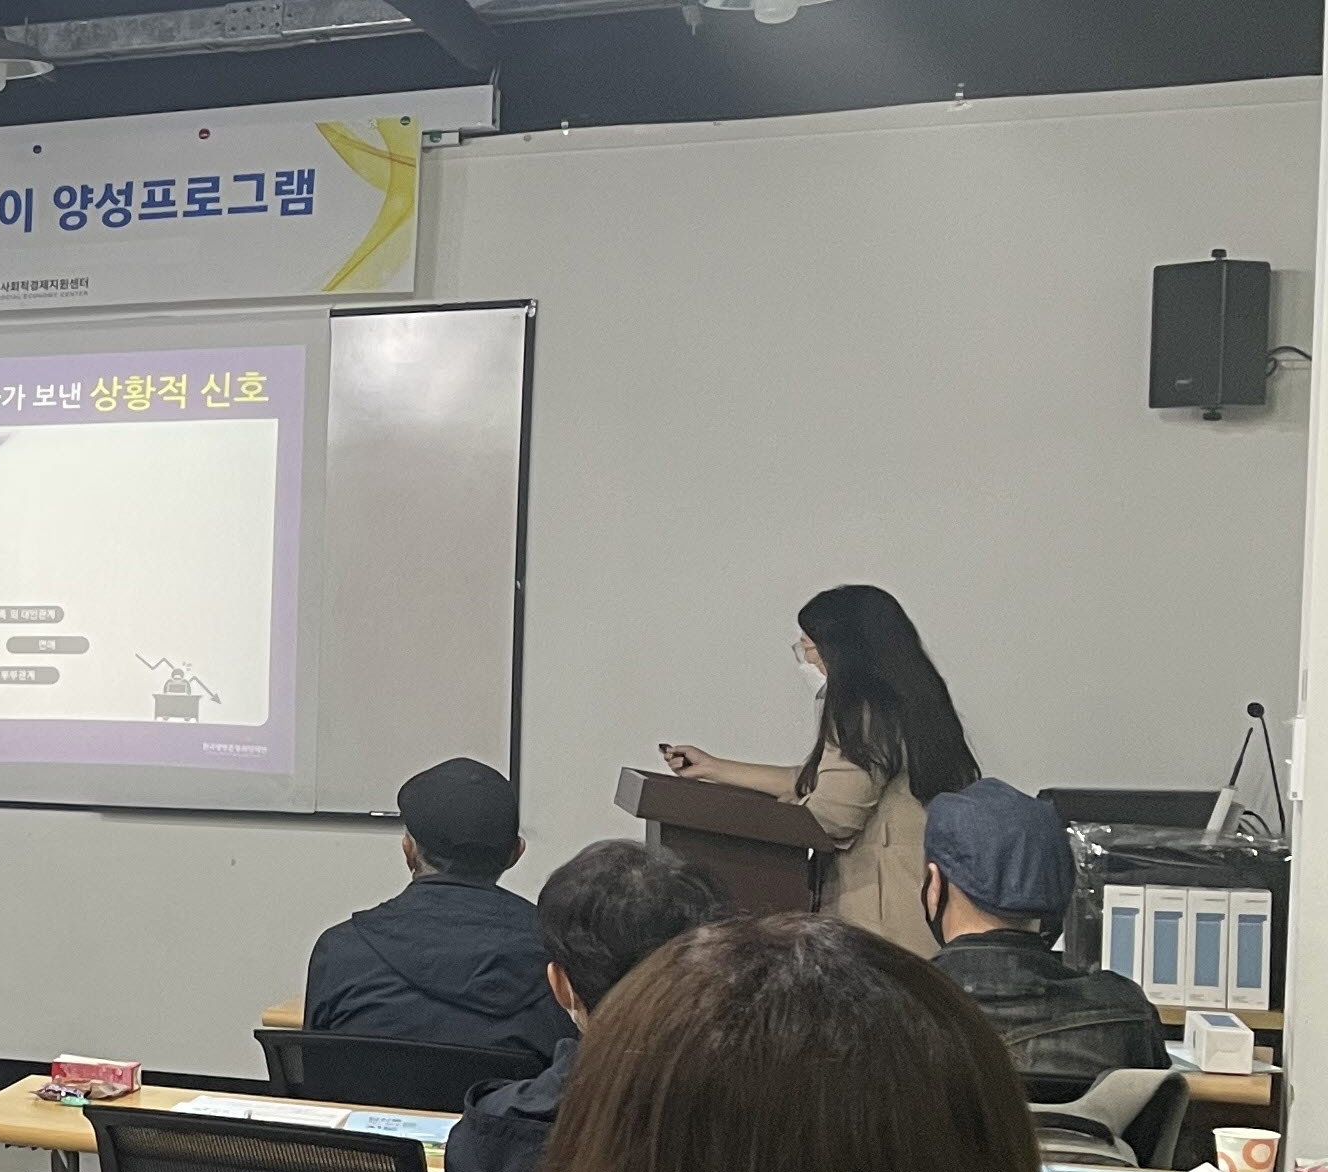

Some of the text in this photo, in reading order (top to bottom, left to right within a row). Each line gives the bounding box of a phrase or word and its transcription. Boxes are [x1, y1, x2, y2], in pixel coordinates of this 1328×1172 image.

[52, 167, 318, 232] 양성프로그램
[32, 381, 83, 411] 보낸
[90, 373, 188, 413] 상황적
[200, 371, 270, 409] 신호
